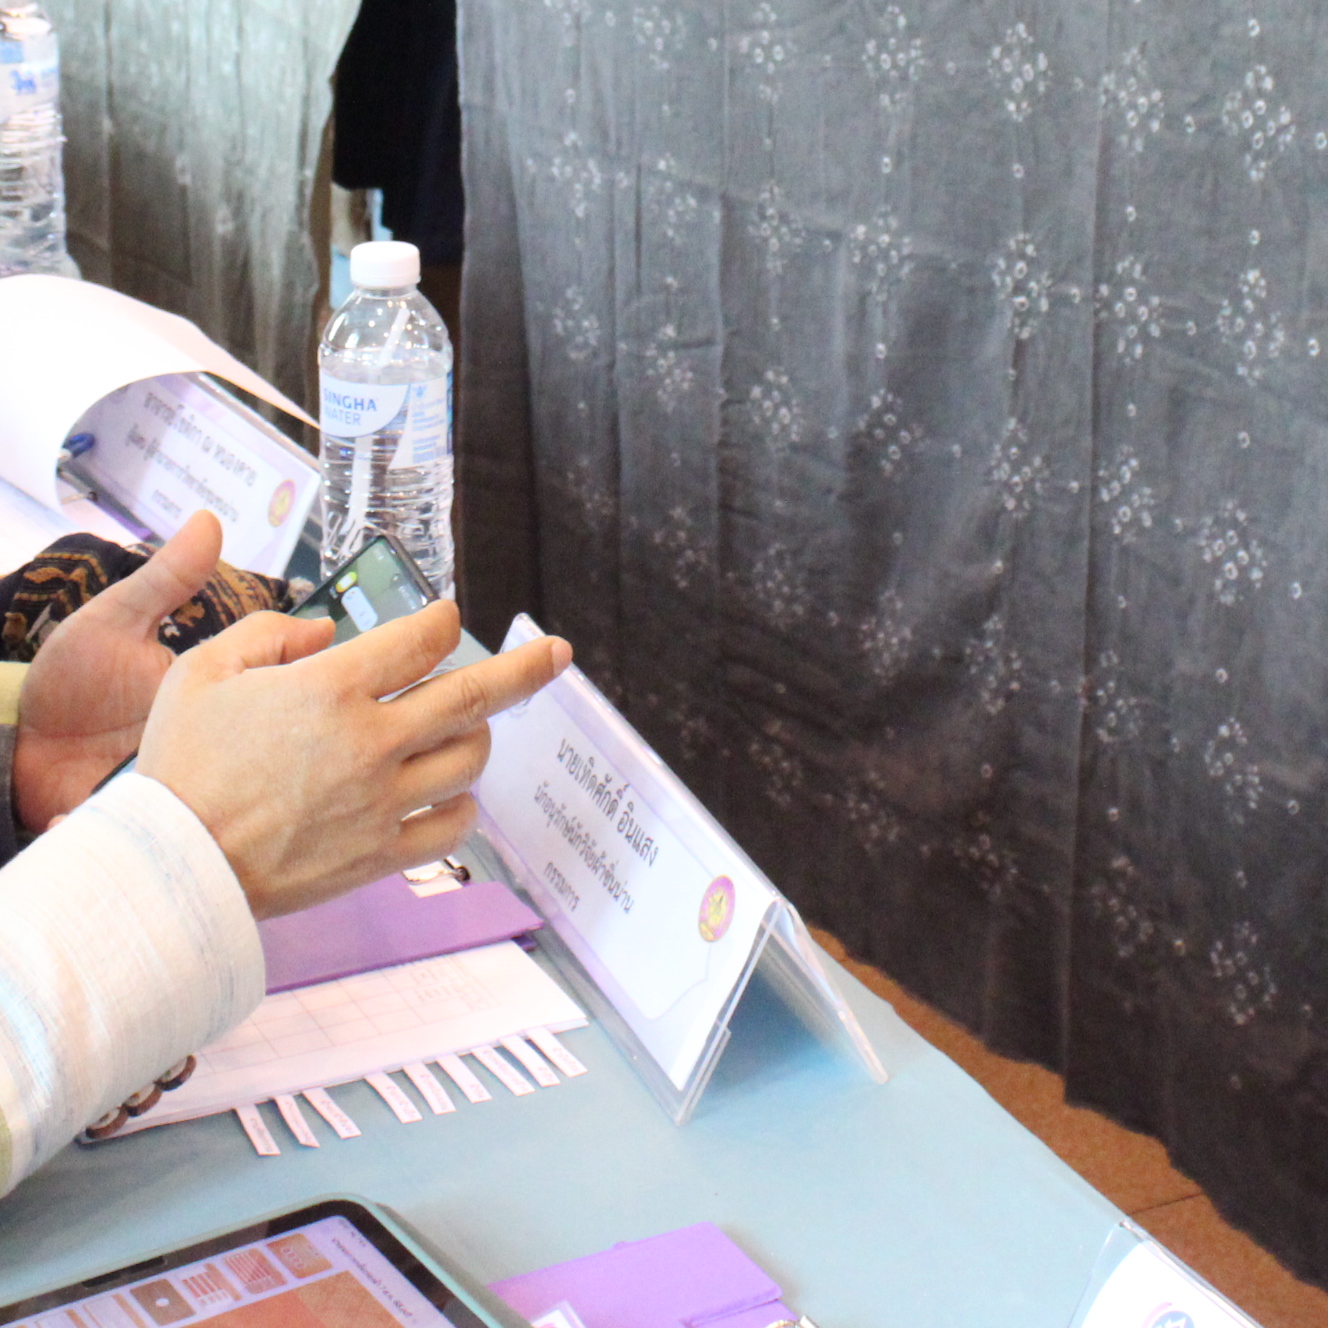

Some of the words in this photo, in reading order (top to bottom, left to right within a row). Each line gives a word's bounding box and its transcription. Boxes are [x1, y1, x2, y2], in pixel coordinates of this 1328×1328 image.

[323, 388, 377, 412] SINGHA
[556, 738, 631, 821] นายเทิดศักดิ์
[617, 801, 659, 867] อินแสง
[543, 861, 581, 912] กรรมการ
